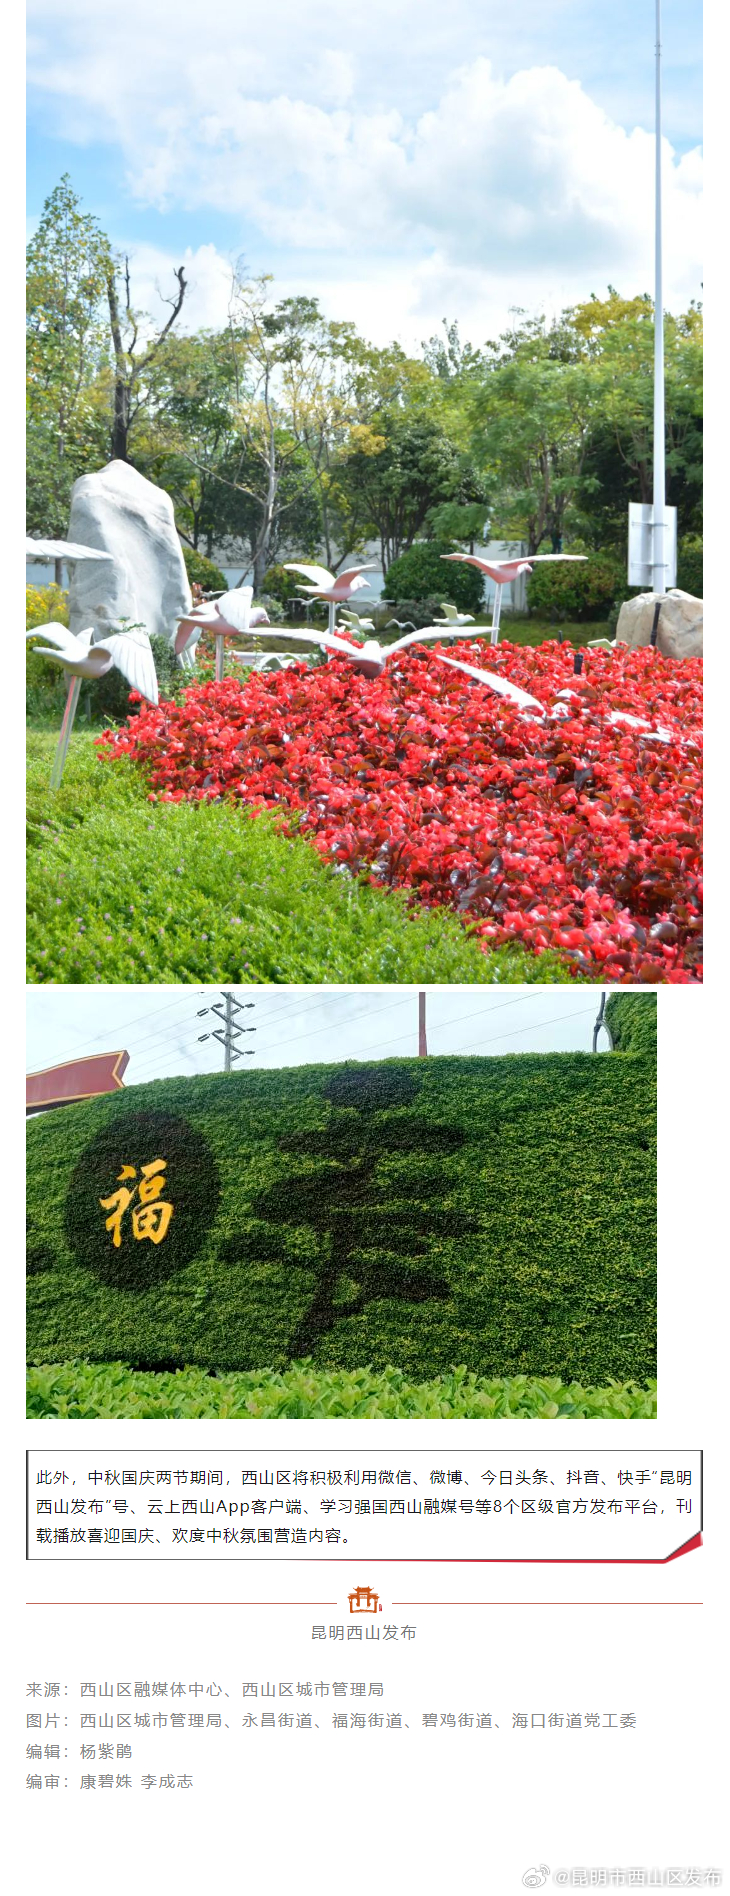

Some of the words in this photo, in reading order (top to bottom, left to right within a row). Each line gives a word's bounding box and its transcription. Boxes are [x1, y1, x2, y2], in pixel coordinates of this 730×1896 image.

[100, 1159, 174, 1248] 福
[36, 1527, 349, 1544] 载播放喜迎国庆、欢度中秋氛围营造内容。
[311, 1624, 417, 1641] 昆明西山发布
[26, 1681, 384, 1698] 来源：西山区融媒体中心、西山区城市管理局
[26, 1712, 637, 1729] 图片：西山区城市管理局、永昌街道、福海街道、碧鸡街道、海口街道党工委
[26, 1743, 132, 1760] 编辑：杨紫鹃
[26, 1773, 133, 1790] 编审：康碧姝
[140, 1773, 194, 1790] 李成志
